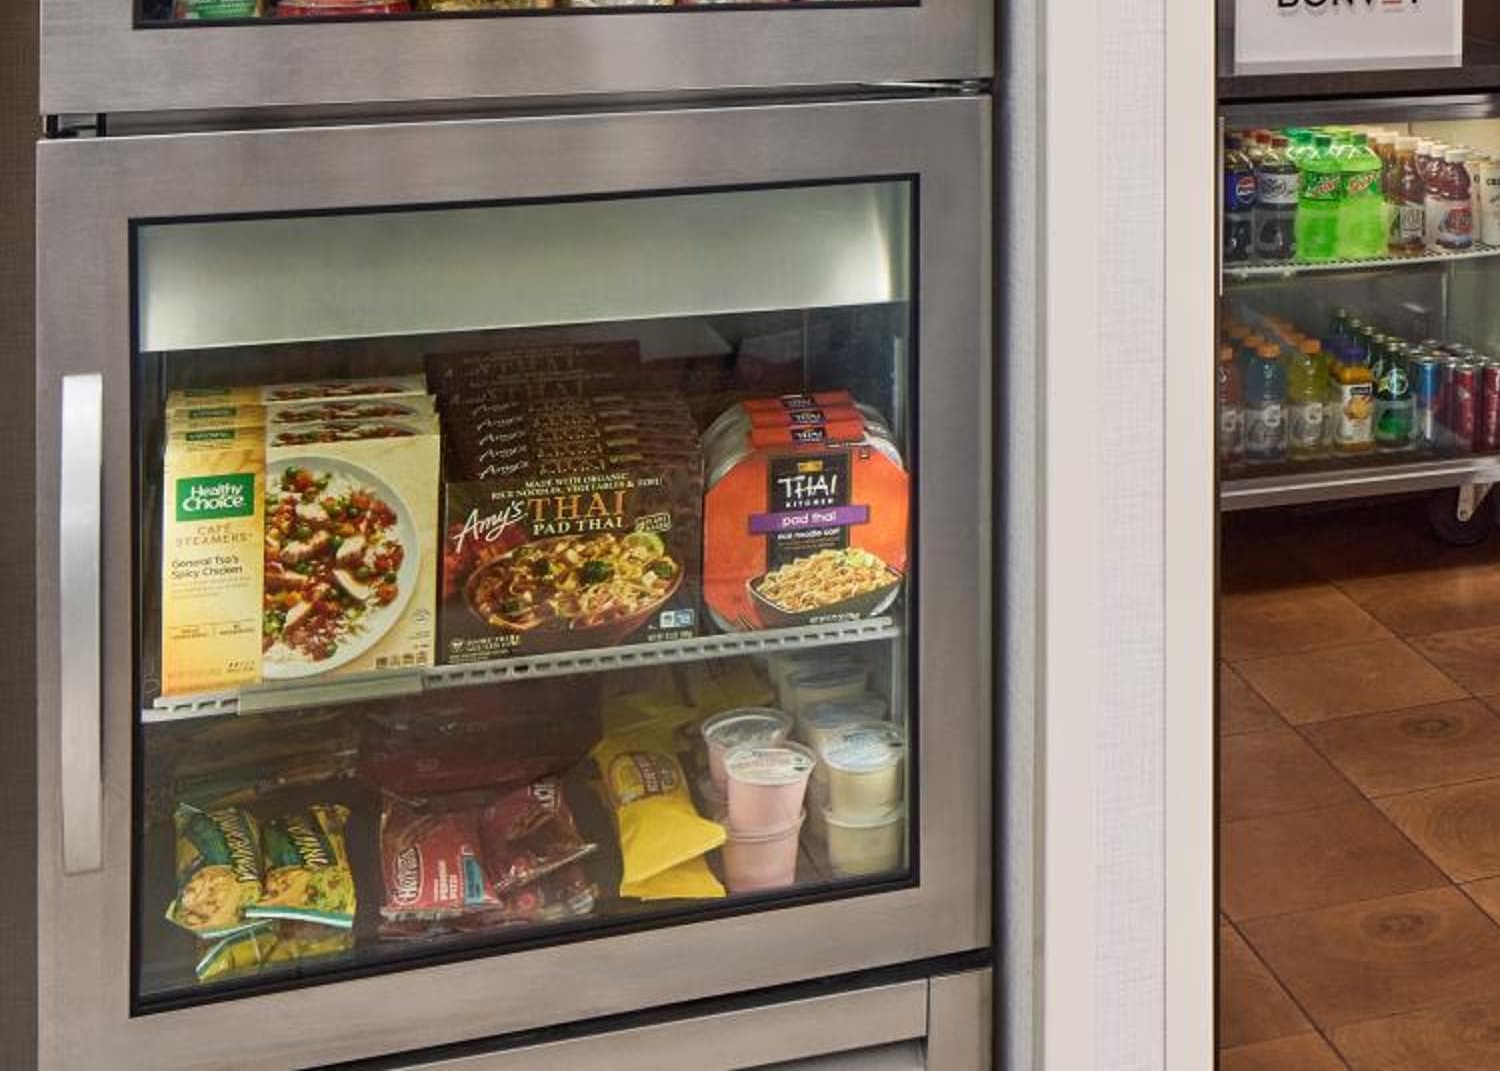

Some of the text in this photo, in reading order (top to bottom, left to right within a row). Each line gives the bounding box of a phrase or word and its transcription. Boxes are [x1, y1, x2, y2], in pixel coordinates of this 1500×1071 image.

[191, 482, 244, 498] Healthy
[777, 473, 838, 499] THAI
[182, 495, 245, 512] Choice
[527, 490, 629, 522] THAI
[451, 500, 525, 554] Amy's
[532, 521, 571, 536] PAD
[575, 516, 624, 531] THAI
[782, 512, 809, 529] pad
[202, 564, 244, 576] Chicken
